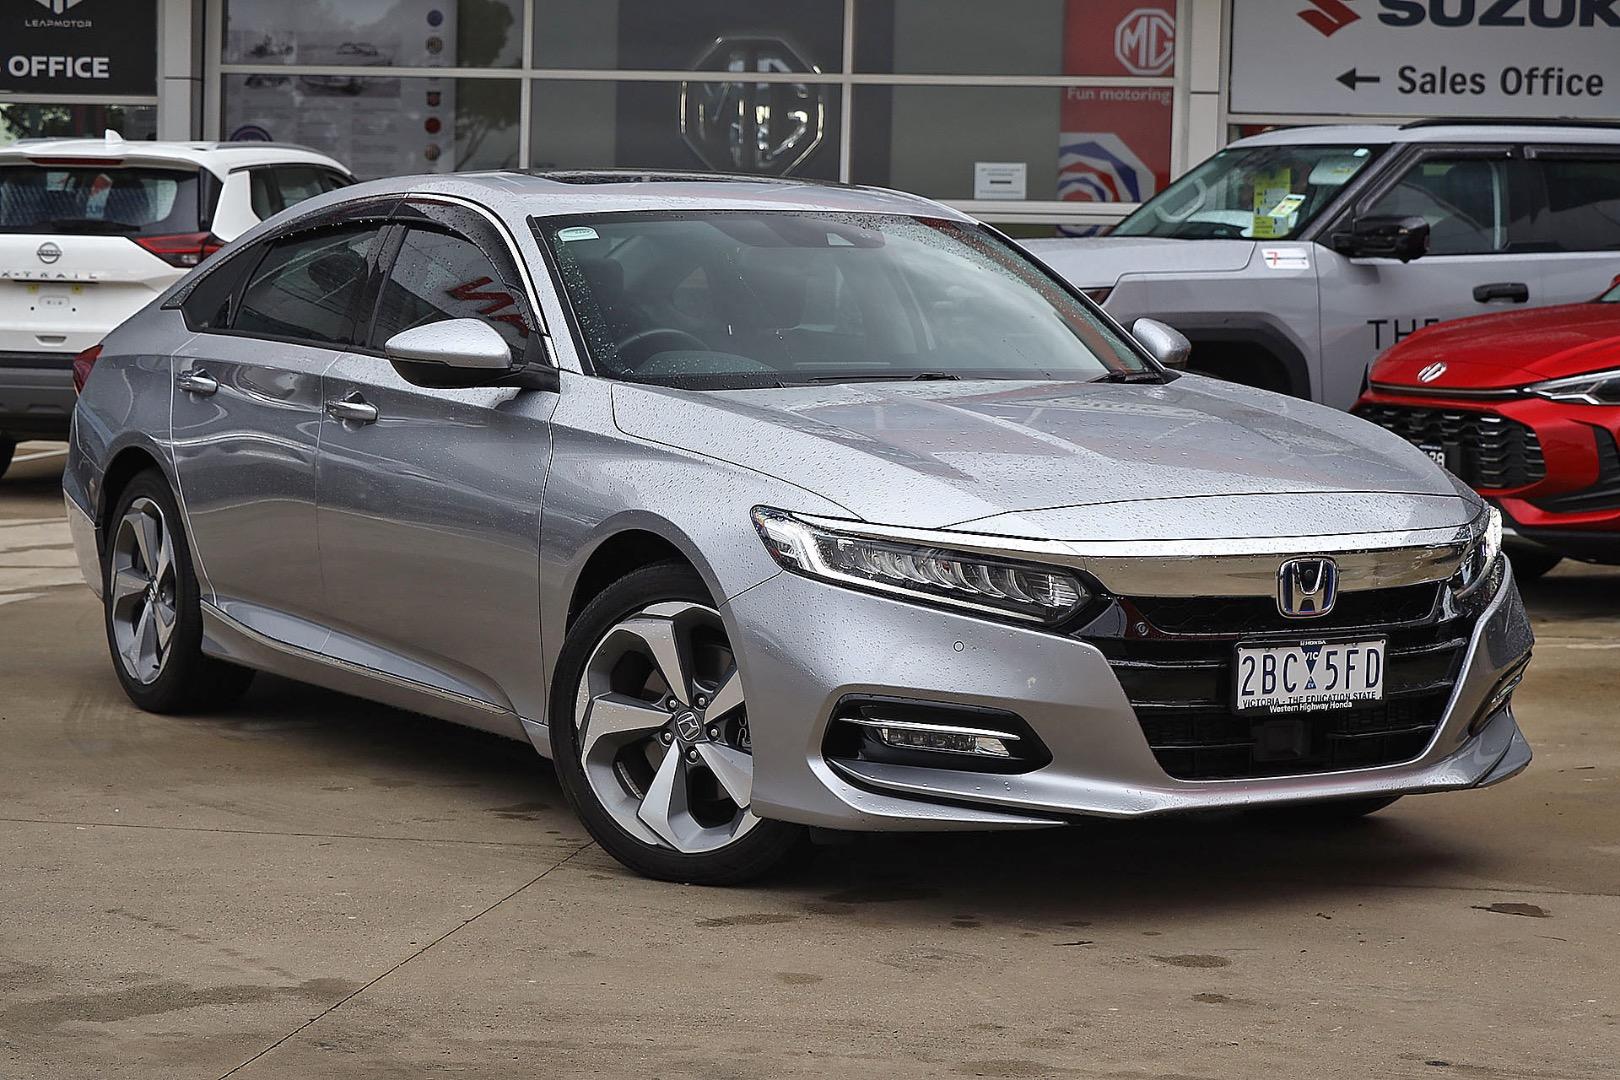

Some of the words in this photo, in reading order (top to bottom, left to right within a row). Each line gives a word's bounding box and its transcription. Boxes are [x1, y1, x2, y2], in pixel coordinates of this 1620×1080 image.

[25, 19, 92, 28] LEAPMOTOR
[1121, 15, 1174, 67] MG
[8, 55, 110, 79] OFFICE
[1397, 65, 1487, 96] Sales
[1500, 66, 1604, 97] Office
[1067, 87, 1094, 100] Fun
[1100, 87, 1170, 106] motoring
[1367, 318, 1440, 350] TH
[1306, 651, 1319, 660] VIC
[1241, 653, 1298, 697] 2BC
[1325, 648, 1381, 691] 5FD
[1242, 697, 1280, 708] VICTORIA
[1288, 696, 1304, 704] THE
[1306, 693, 1351, 703] EDUCATION
[1352, 691, 1376, 700] STATE
[1269, 703, 1299, 714] Western
[1300, 700, 1329, 713] Highway
[1330, 700, 1353, 710] Honda
